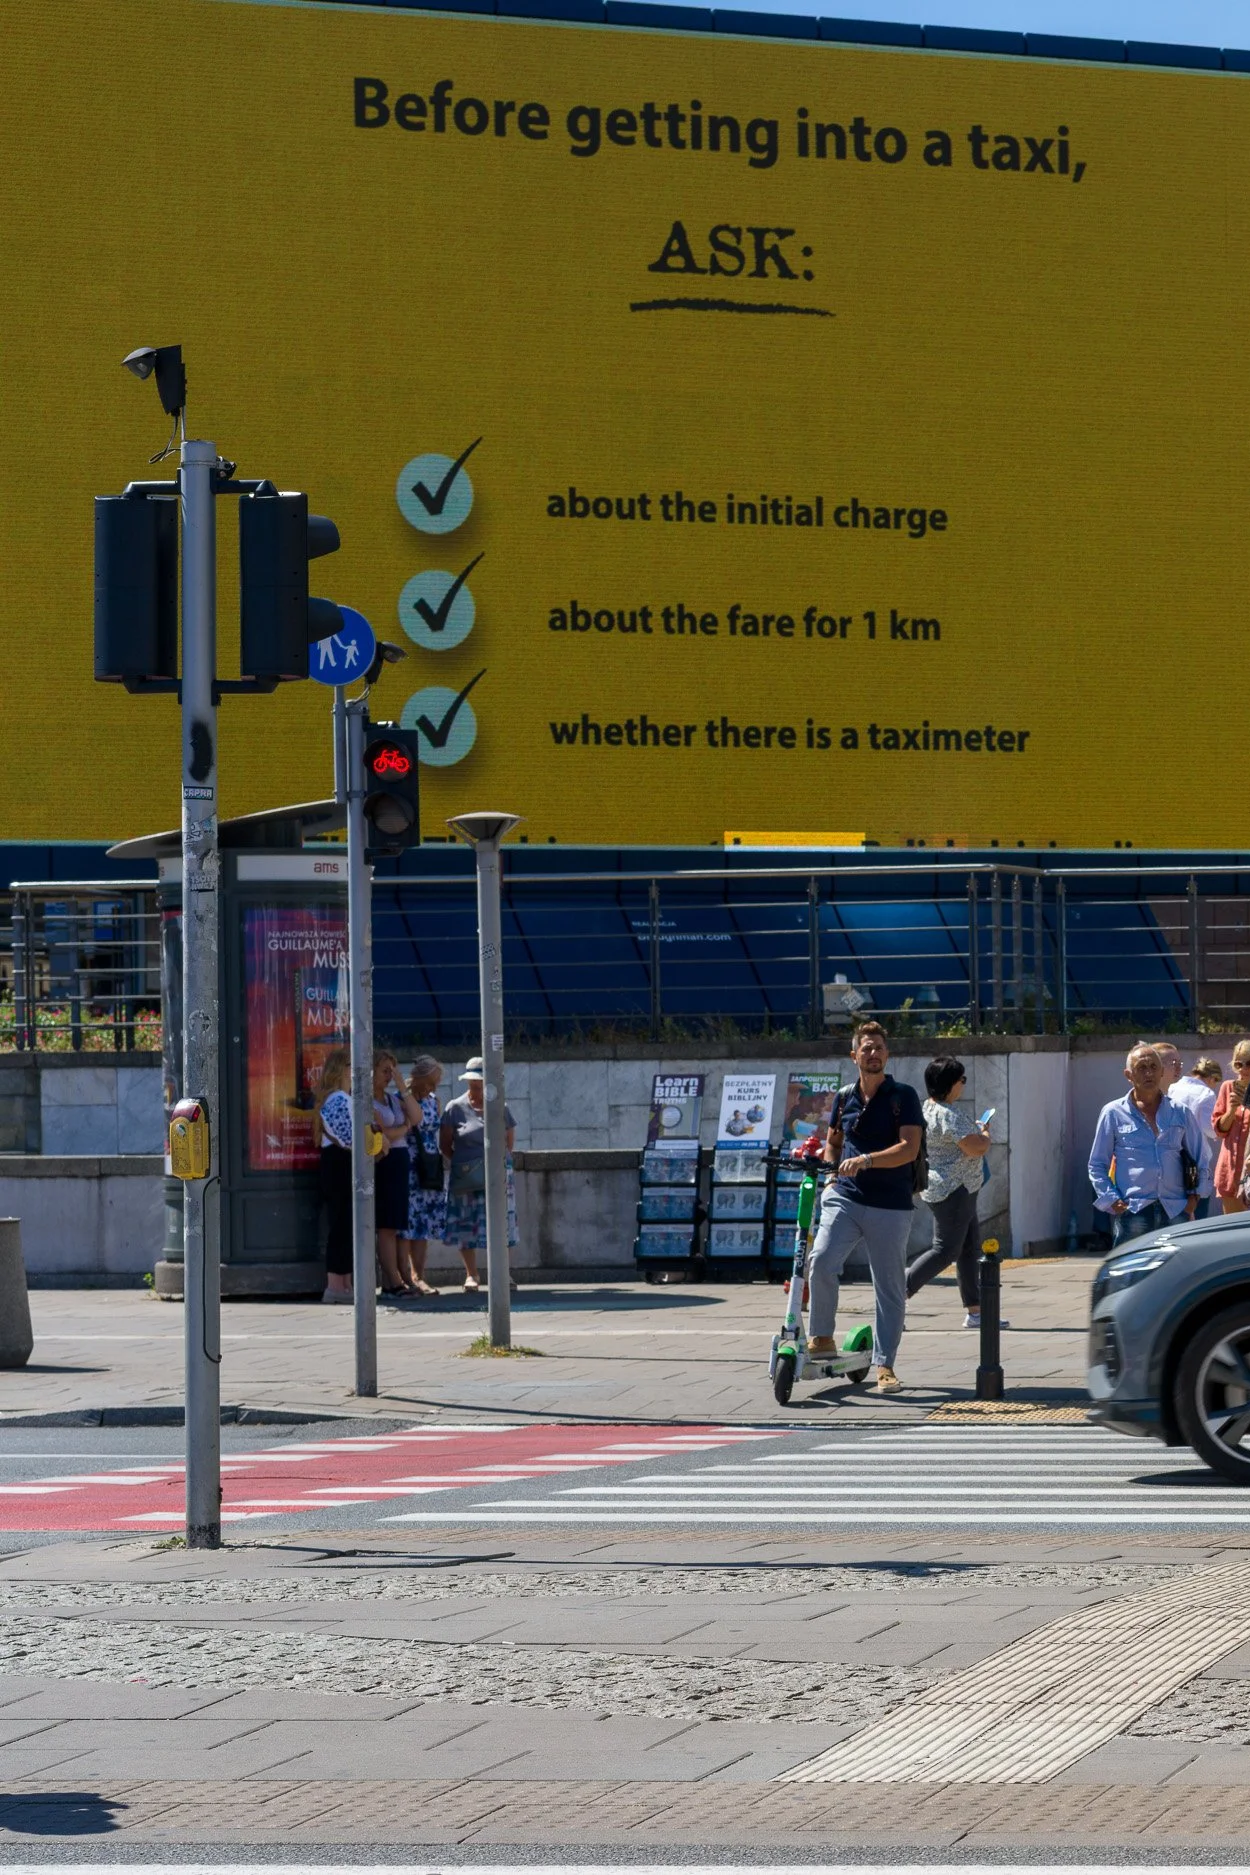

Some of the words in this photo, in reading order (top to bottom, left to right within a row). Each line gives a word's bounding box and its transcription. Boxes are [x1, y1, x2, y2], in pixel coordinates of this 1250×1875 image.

[354, 77, 550, 140] Before
[566, 99, 779, 169] getting
[797, 107, 907, 164] into
[923, 130, 952, 166] a
[967, 125, 1086, 184] taxi,
[648, 221, 814, 282] ASK:
[547, 487, 651, 522] about
[660, 490, 717, 523] the
[726, 493, 823, 527] initial
[833, 497, 948, 539] charge
[548, 600, 653, 635] about
[660, 603, 719, 636] the
[726, 604, 795, 638] fare
[802, 606, 853, 639] for
[862, 610, 876, 640] 1
[890, 609, 940, 640] km
[549, 713, 697, 748] whether
[704, 716, 797, 750] there
[805, 718, 831, 750] is
[840, 727, 859, 750] a
[867, 720, 1030, 752] taximeter
[184, 787, 213, 799] CAPRA
[314, 862, 339, 873] ams
[268, 930, 318, 938] NAJNOWSZA
[268, 939, 344, 951] GUILLAUME'A
[655, 1076, 698, 1086] Learn
[654, 1086, 698, 1097] BIBLE
[812, 1083, 838, 1092] ВАС
